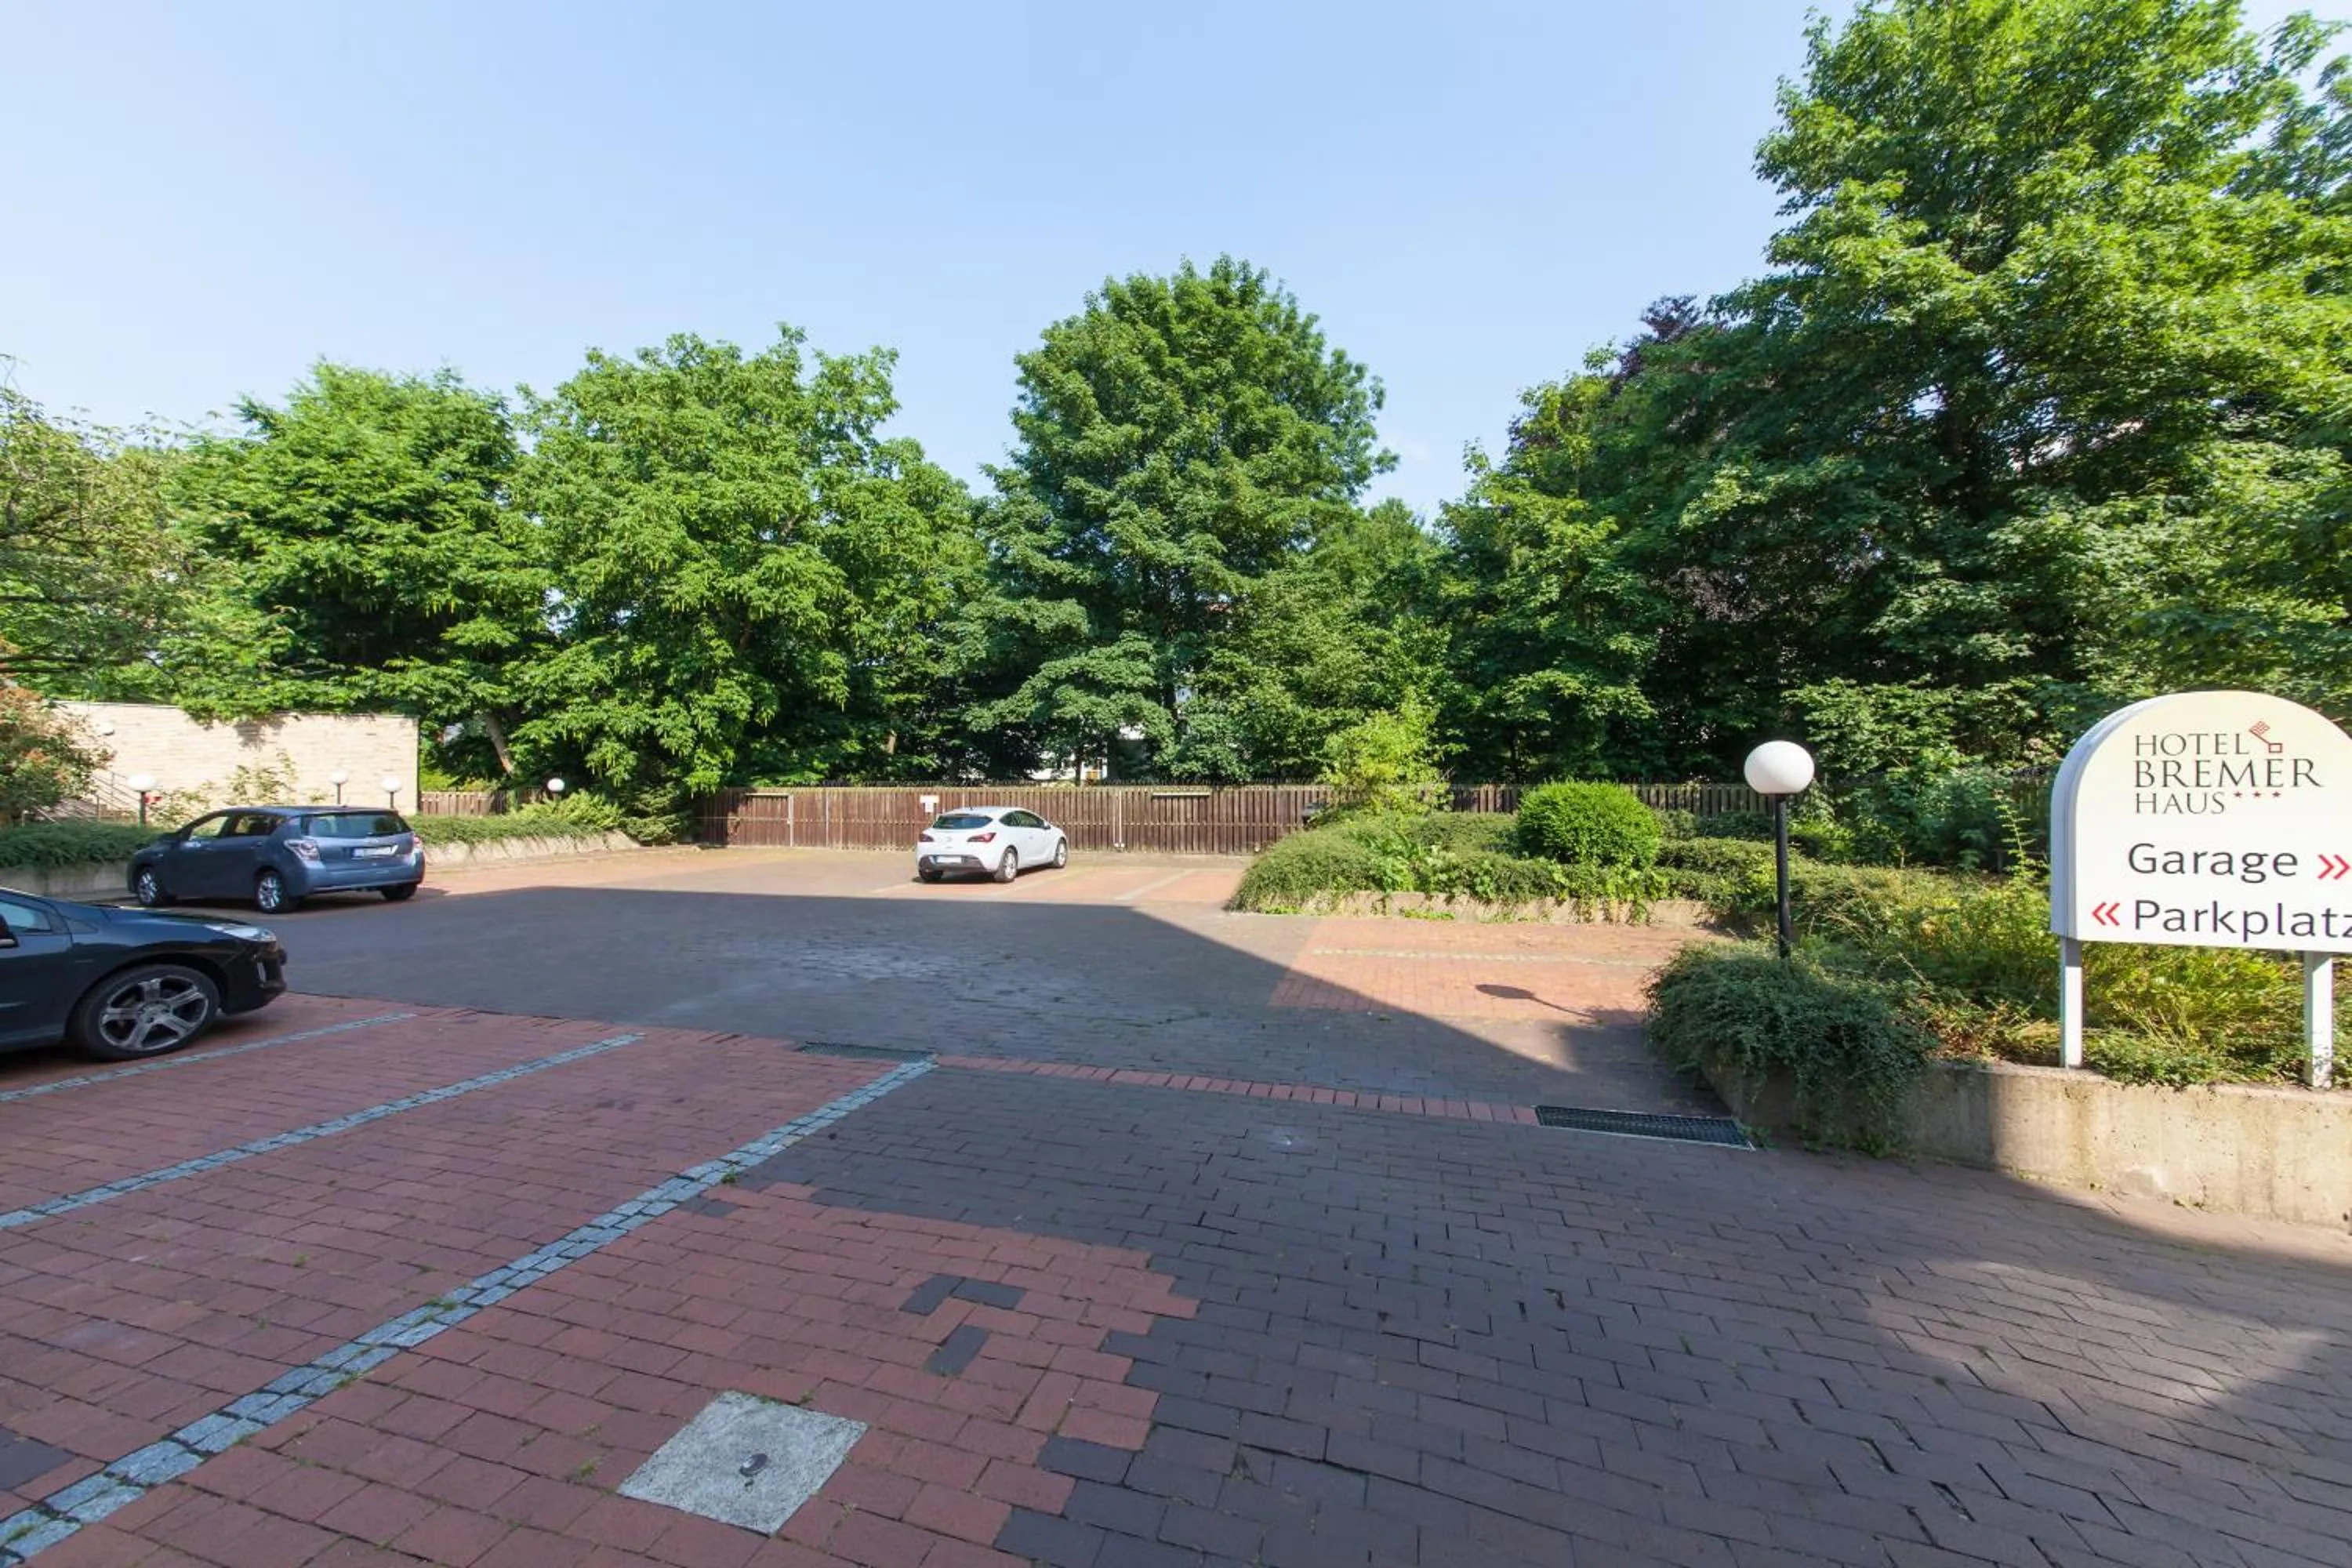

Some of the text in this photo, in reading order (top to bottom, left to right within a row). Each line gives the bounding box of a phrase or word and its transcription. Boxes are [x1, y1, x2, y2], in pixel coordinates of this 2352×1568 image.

[2135, 733, 2249, 757] HOTEL
[2133, 757, 2324, 788] BREMER
[2135, 790, 2225, 815] HAUS
[2128, 843, 2298, 884] Garage
